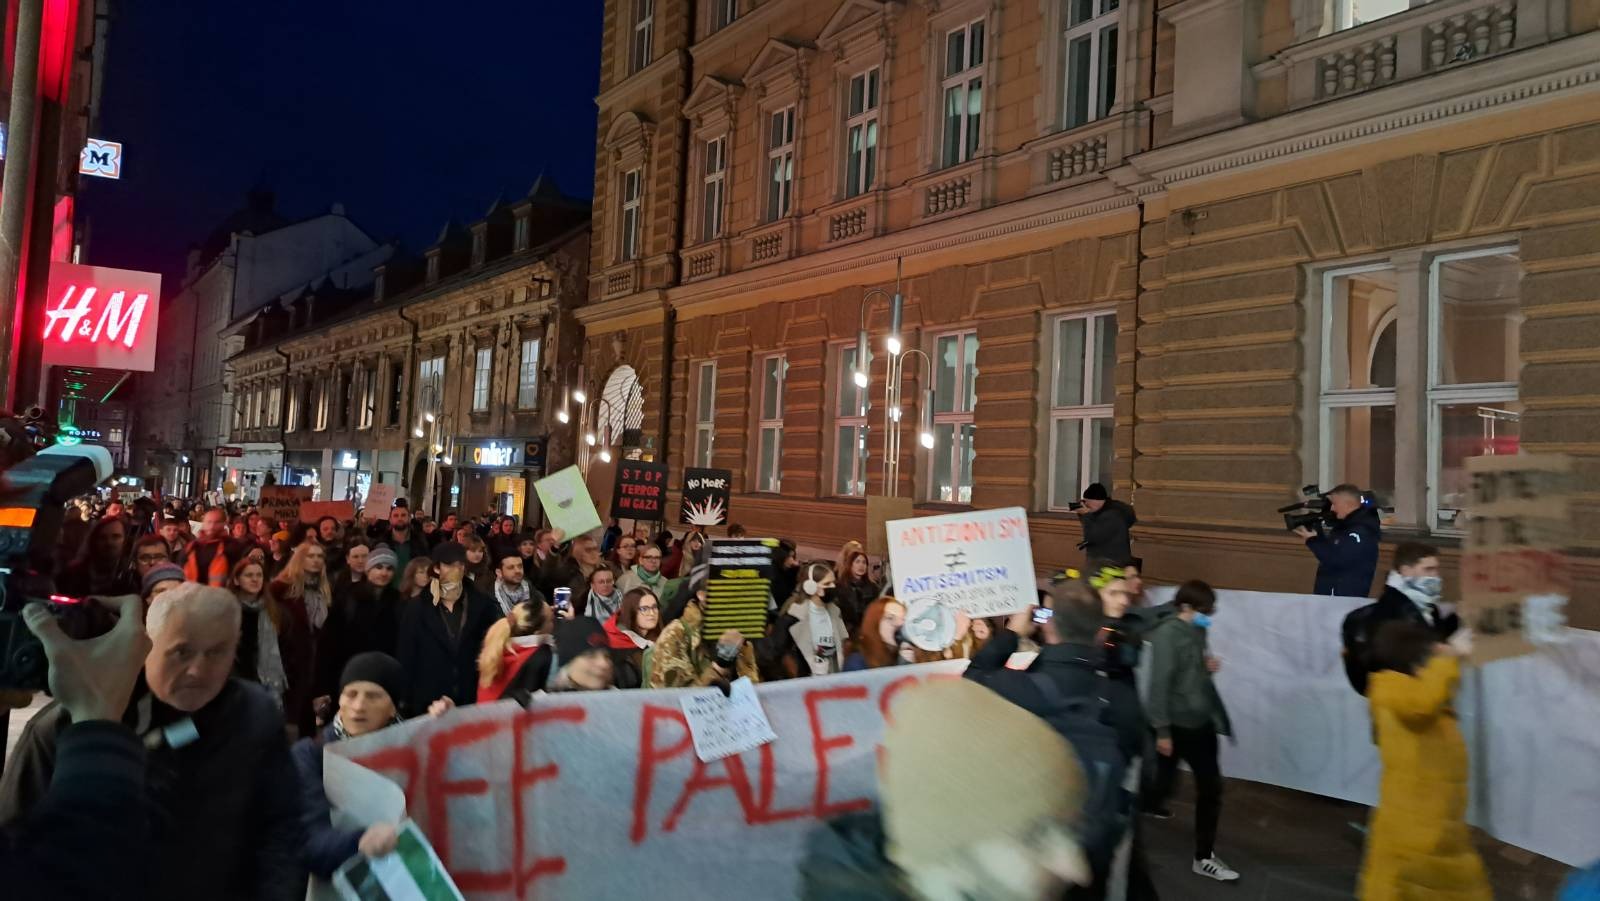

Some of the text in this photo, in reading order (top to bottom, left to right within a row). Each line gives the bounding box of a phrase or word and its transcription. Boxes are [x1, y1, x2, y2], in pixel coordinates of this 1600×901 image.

[89, 150, 110, 167] M
[43, 285, 148, 348] H&M
[623, 469, 662, 482] STOP
[621, 484, 660, 496] TERROR
[688, 479, 700, 490] NO
[620, 498, 658, 510] IN GAZA
